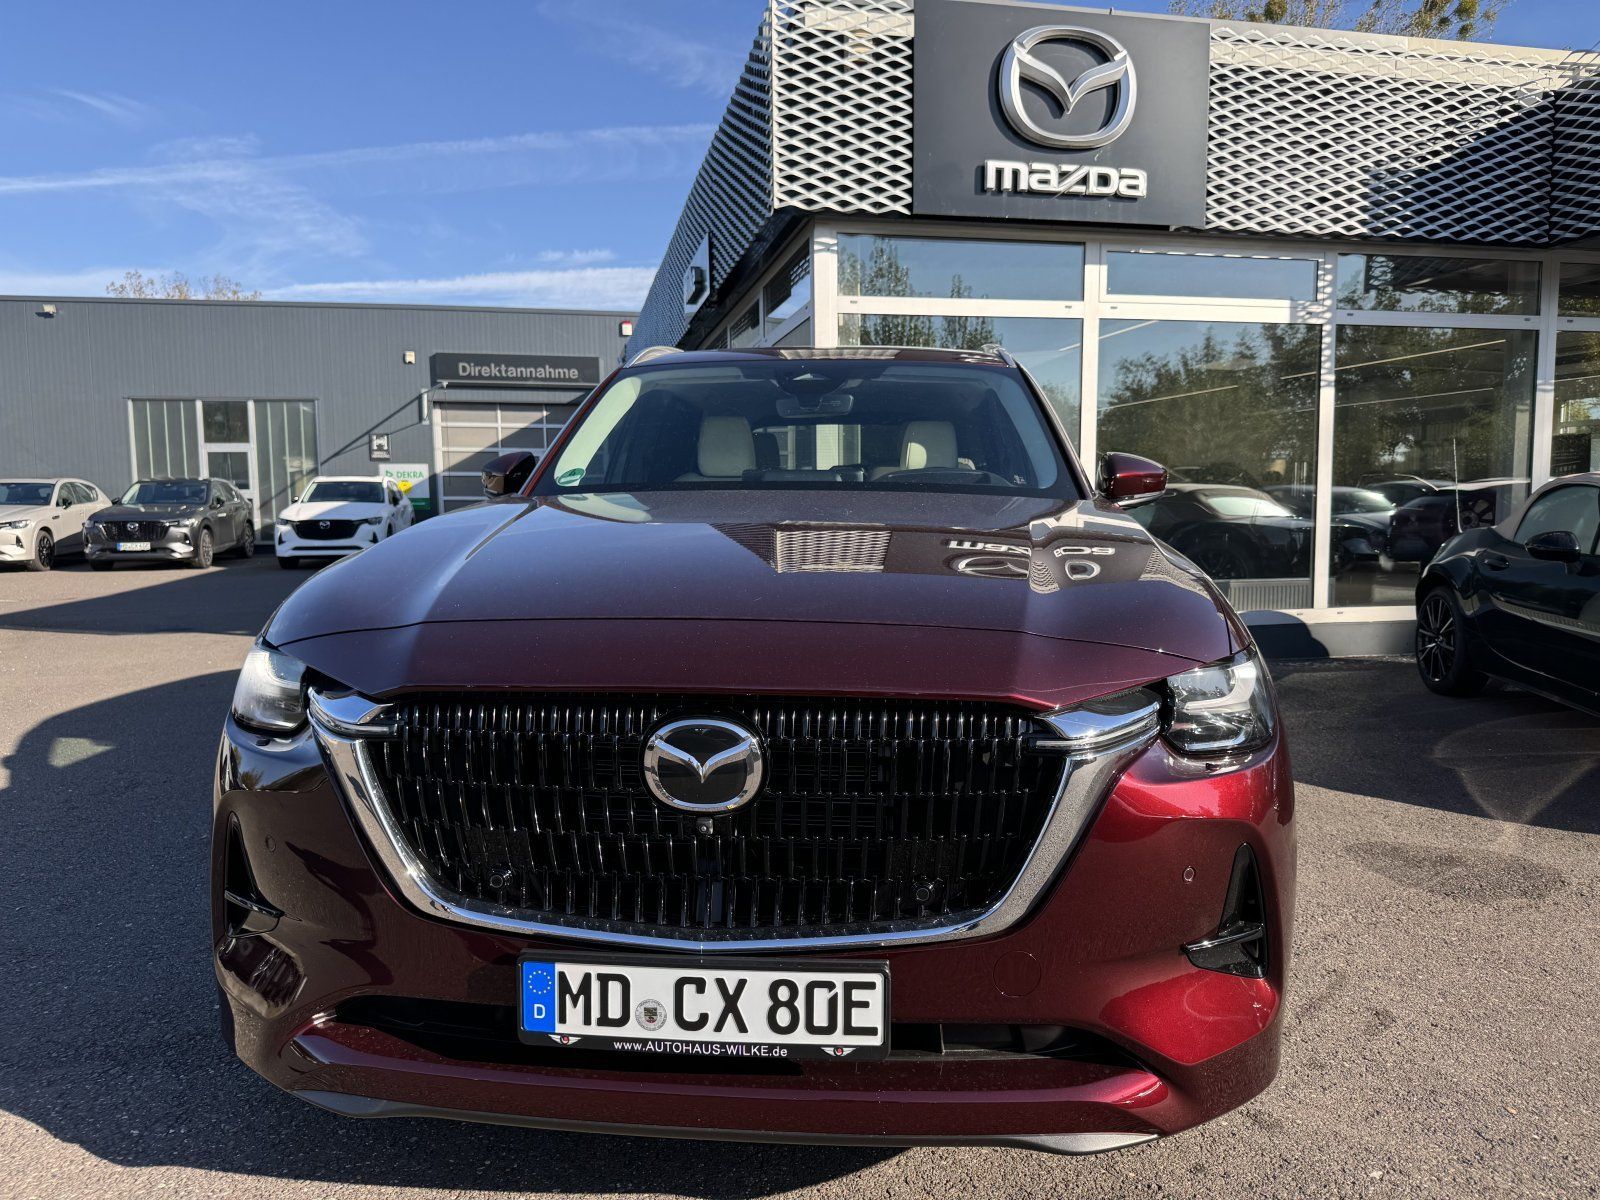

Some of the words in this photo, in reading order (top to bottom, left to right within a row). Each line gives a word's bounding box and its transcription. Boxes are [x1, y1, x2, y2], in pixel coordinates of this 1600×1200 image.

[985, 159, 1148, 199] mazda
[457, 361, 580, 380] Direktannahme
[396, 470, 425, 479] DEKRA
[533, 1003, 547, 1019] D
[557, 970, 631, 1028] MD
[673, 976, 749, 1034] CX
[766, 978, 879, 1037] 80E
[613, 1040, 789, 1058] www.AUTOHAUS-WILKE.de
